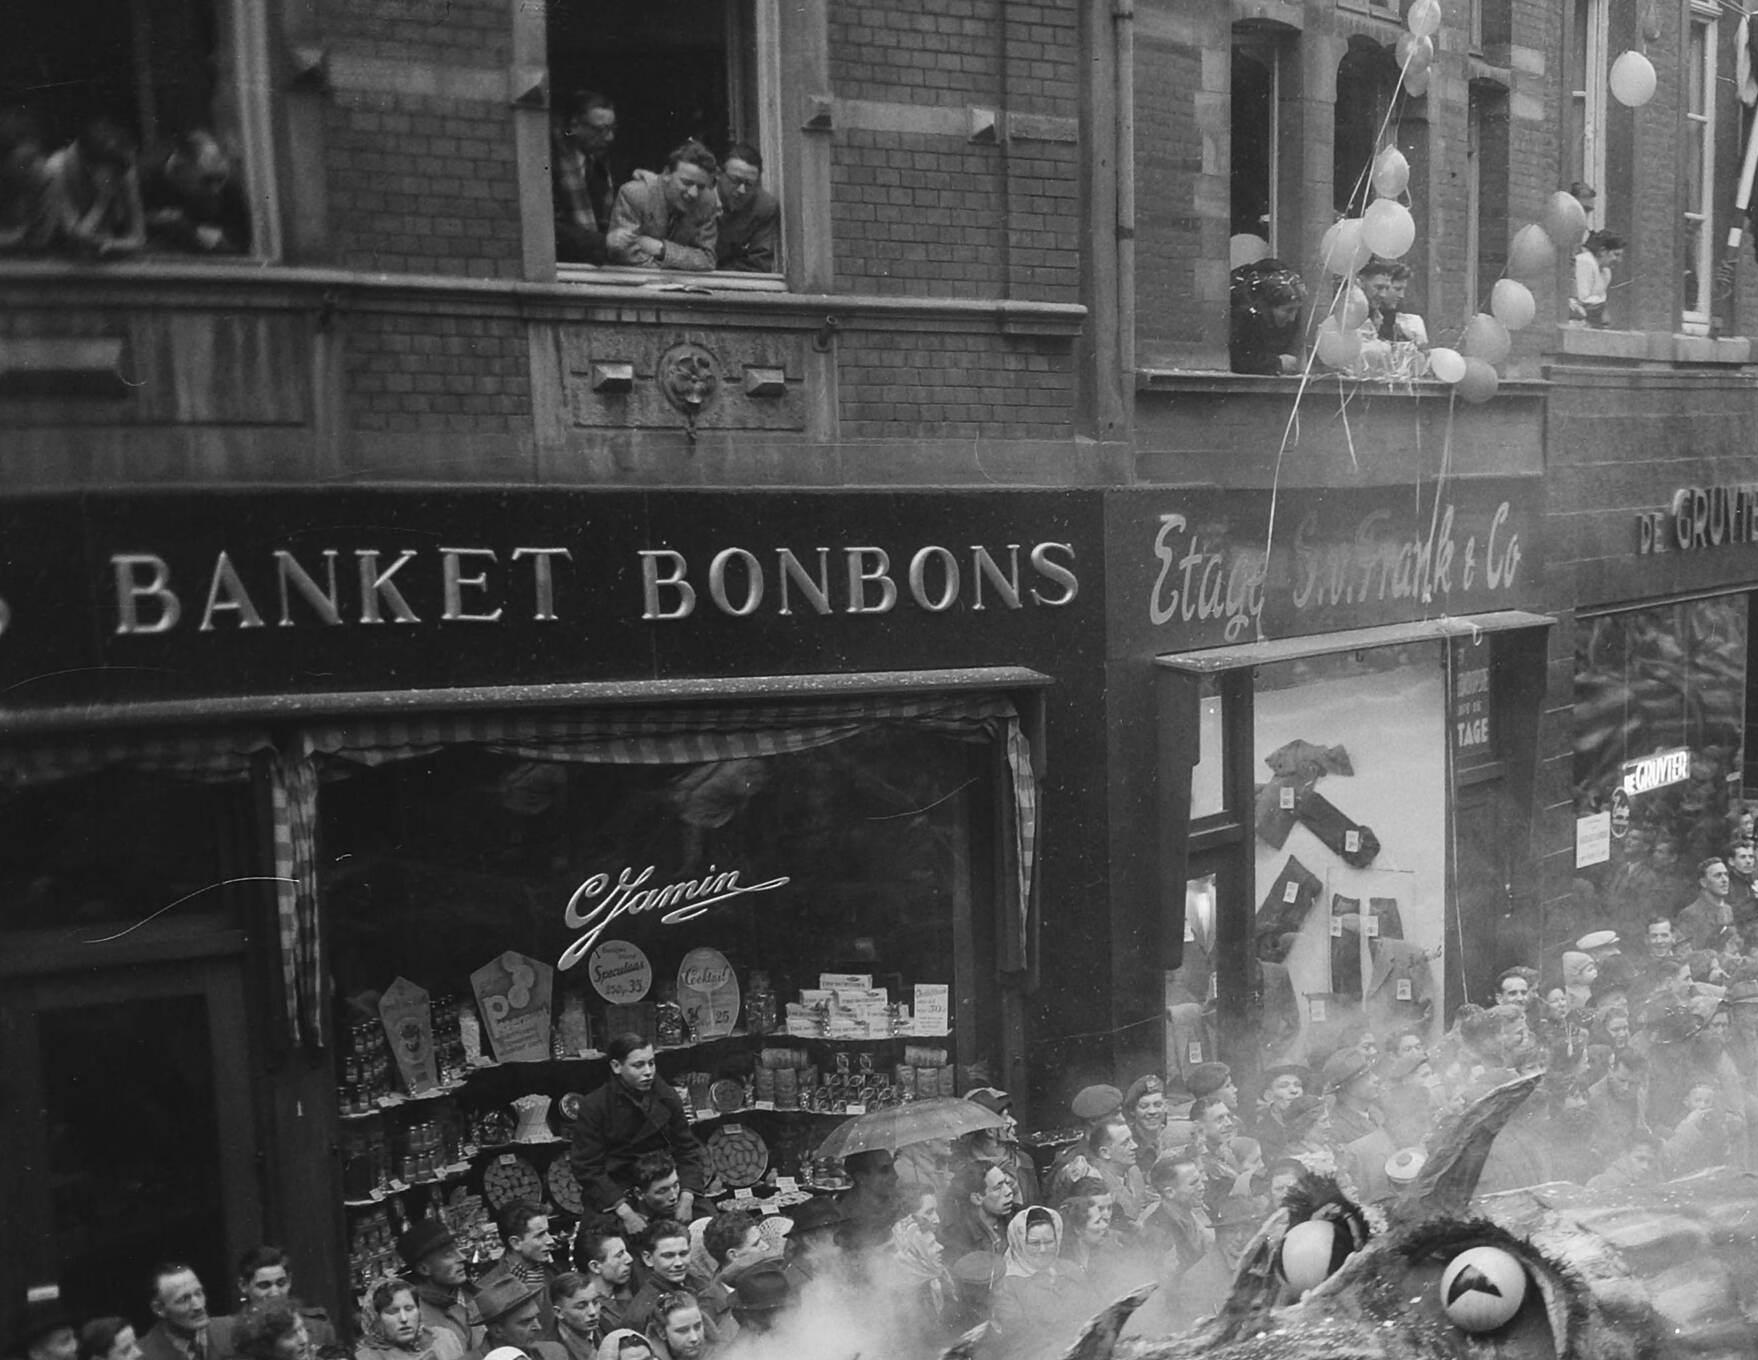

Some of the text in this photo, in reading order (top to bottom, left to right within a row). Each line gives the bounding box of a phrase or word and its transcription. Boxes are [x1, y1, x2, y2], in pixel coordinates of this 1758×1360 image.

[1149, 513, 1267, 642] Etage
[1635, 511, 1666, 555] DE
[109, 547, 574, 634] BANKET
[636, 541, 1079, 621] BONBONS
